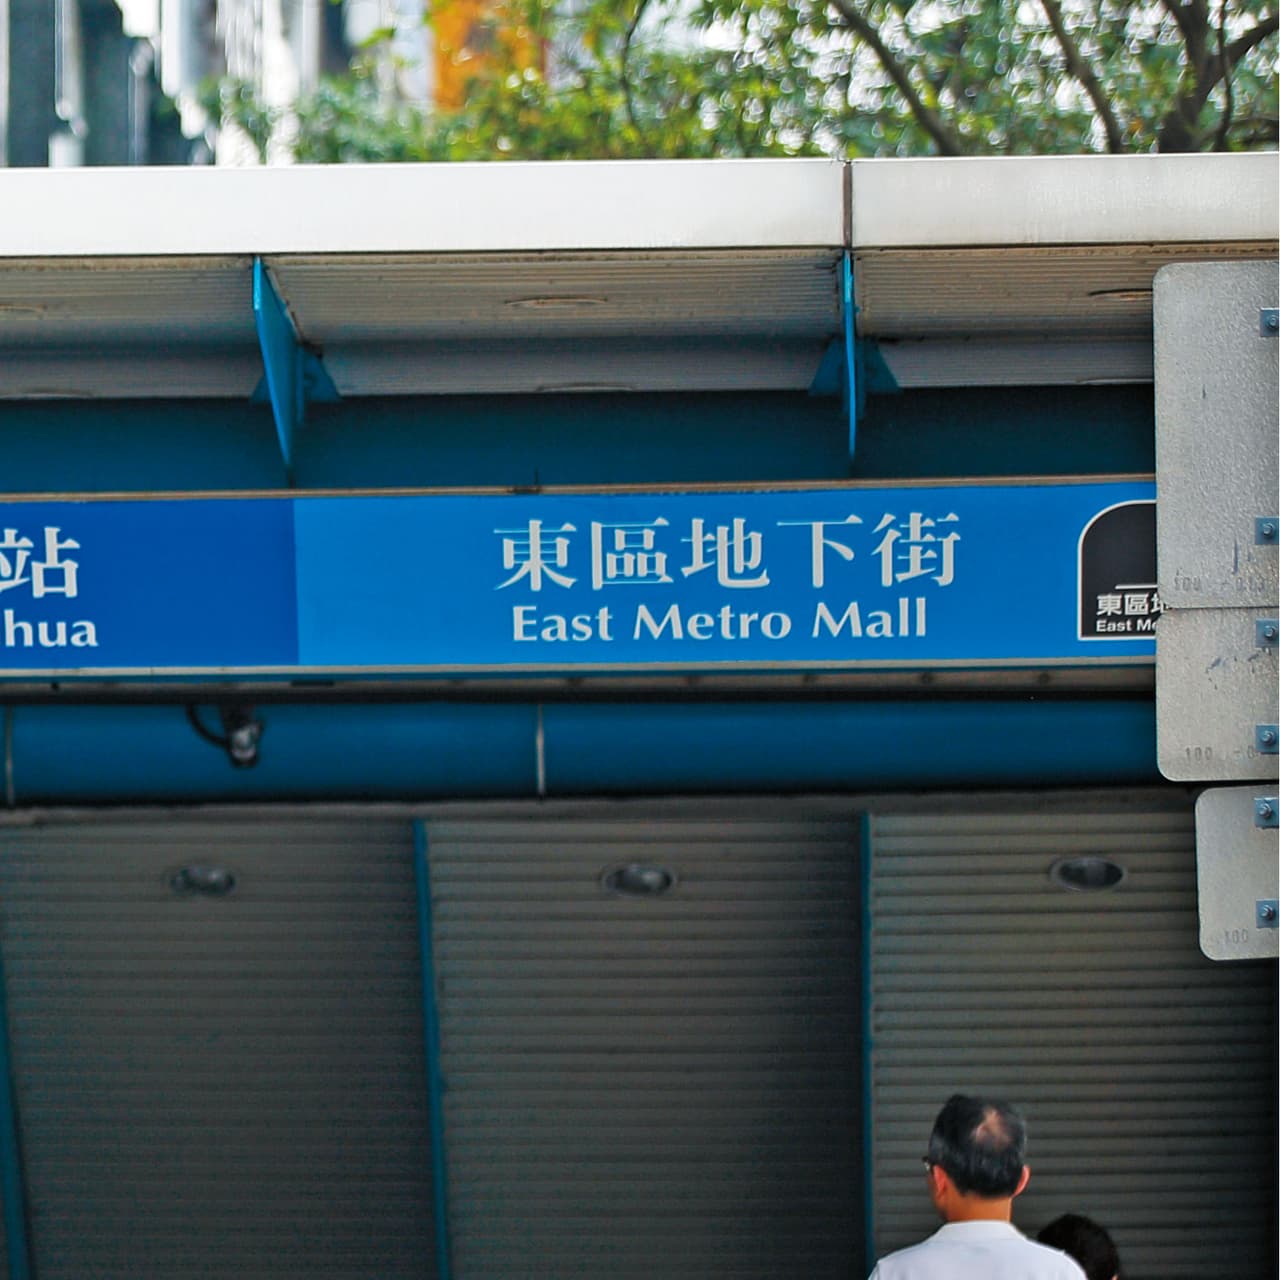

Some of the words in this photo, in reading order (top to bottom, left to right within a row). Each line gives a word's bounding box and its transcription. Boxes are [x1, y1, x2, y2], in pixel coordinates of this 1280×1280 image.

[494, 512, 962, 592] 東區地下街
[512, 606, 614, 642] East
[633, 602, 792, 641] Metro
[811, 597, 928, 638] Mall
[1096, 618, 1133, 632] East
